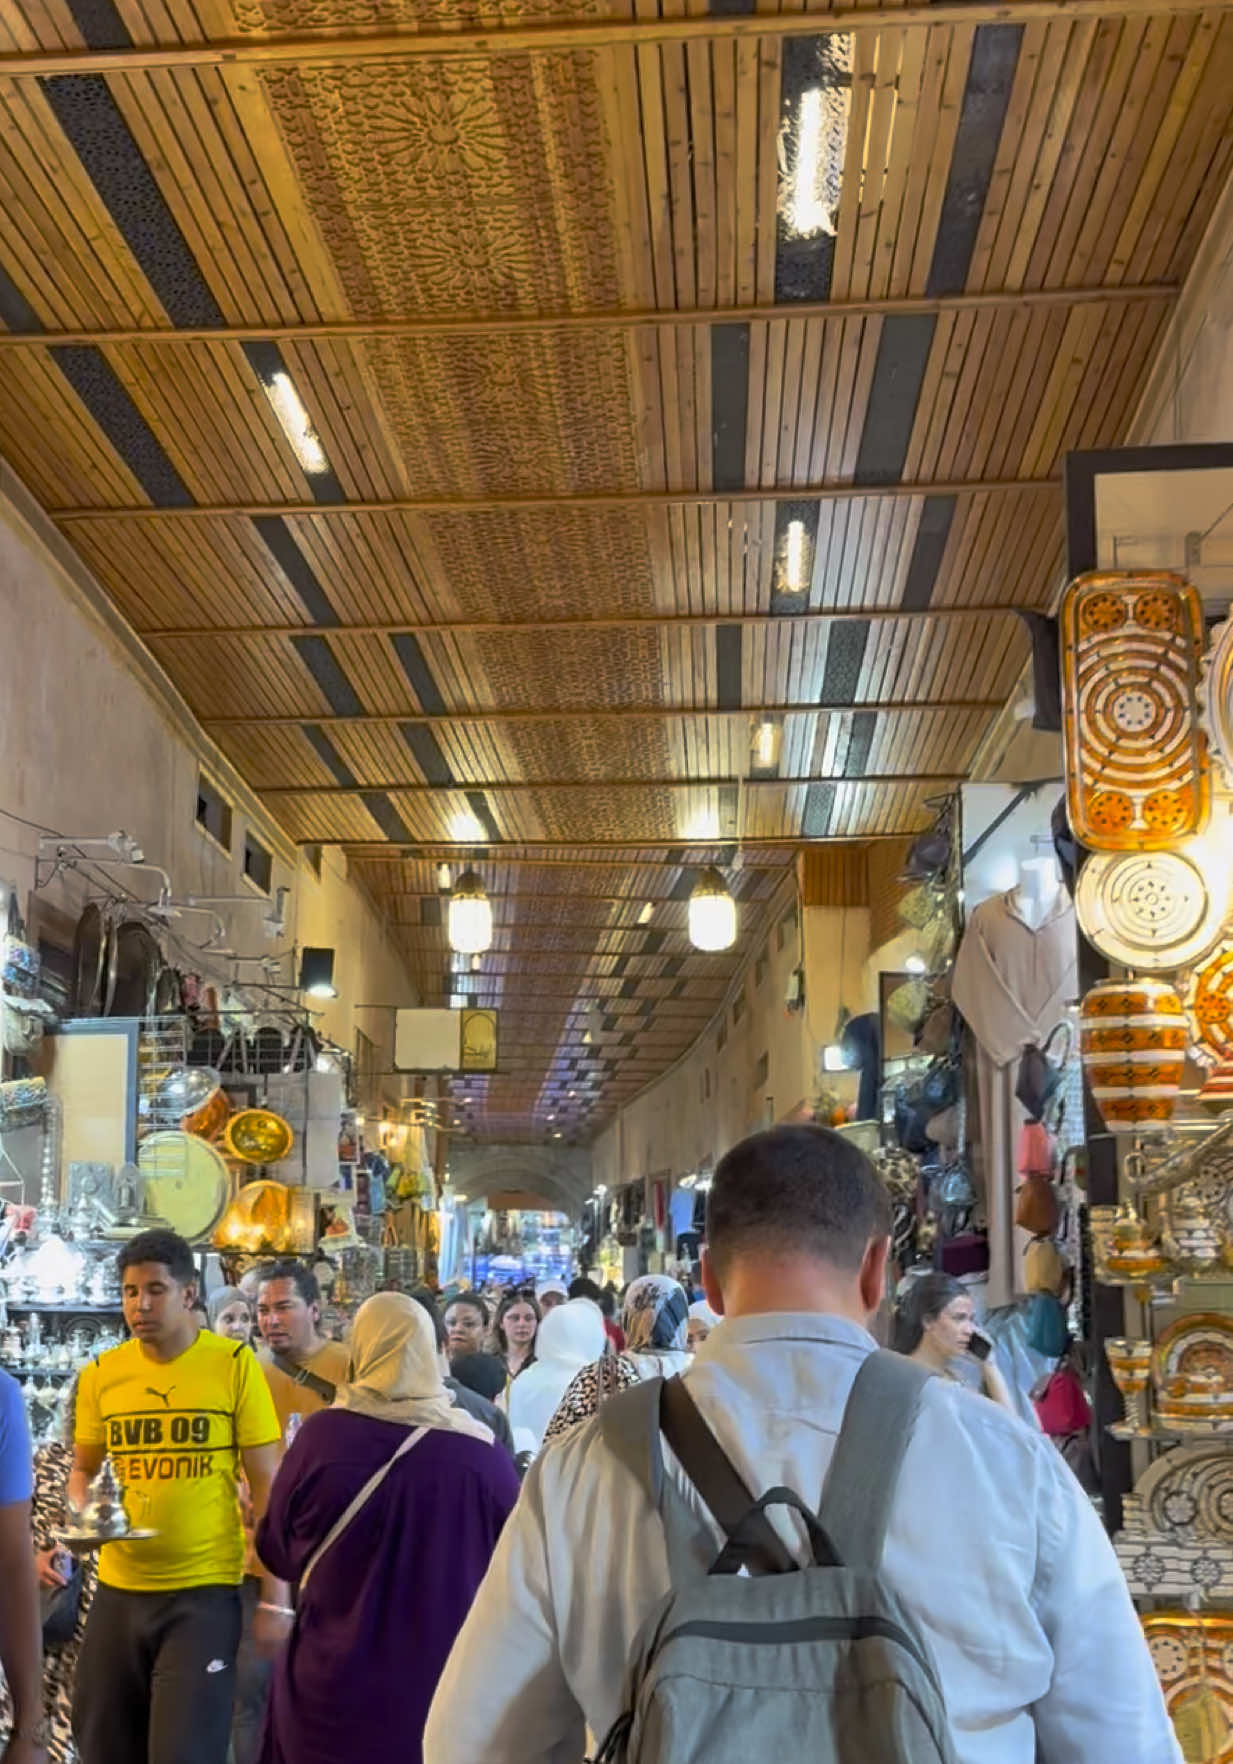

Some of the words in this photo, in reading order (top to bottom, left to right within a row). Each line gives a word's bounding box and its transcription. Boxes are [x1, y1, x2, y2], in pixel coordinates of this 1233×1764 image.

[110, 1418, 163, 1446] BVB
[170, 1415, 210, 1444] 09
[128, 1454, 213, 1480] EVONIK
